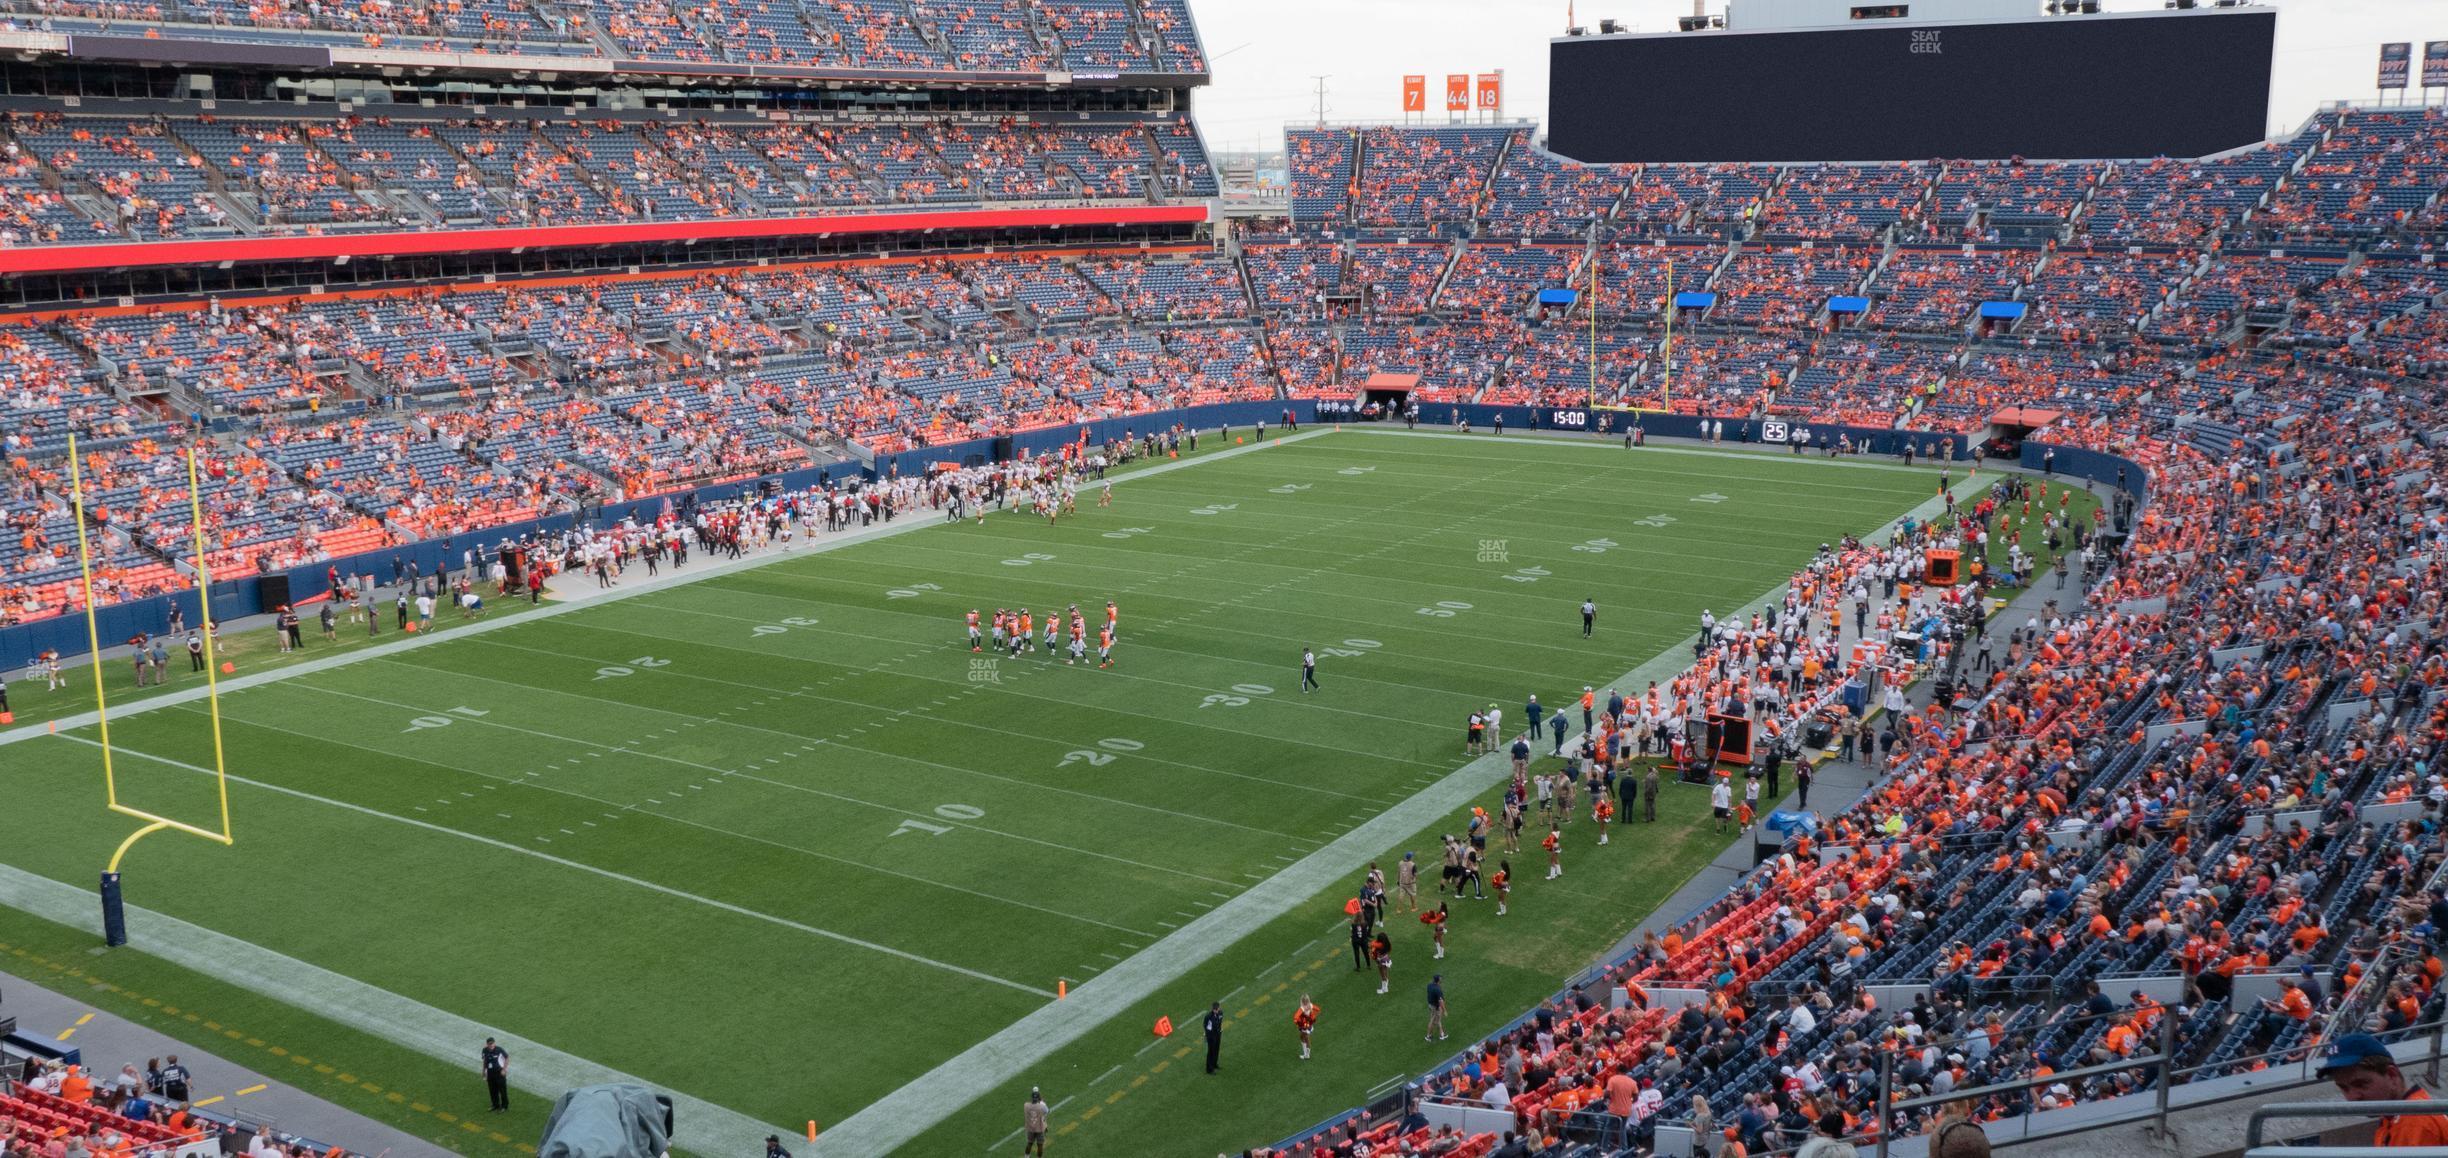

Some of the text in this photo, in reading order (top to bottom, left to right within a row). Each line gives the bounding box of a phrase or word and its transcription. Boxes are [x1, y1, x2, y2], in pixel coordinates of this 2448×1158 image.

[2380, 60, 2407, 72] 1997
[1409, 91, 1418, 106] 7
[1448, 91, 1467, 106] 44
[1480, 90, 1496, 105] 18
[1553, 411, 1585, 425] 15:00
[1766, 424, 1784, 438] 25
[1268, 484, 1308, 494] 20
[1190, 504, 1236, 515] 30
[1633, 516, 1677, 527] 20
[1102, 528, 1150, 539] 40
[1571, 540, 1619, 553] 30
[1000, 553, 1056, 566] 50
[1501, 568, 1552, 582] 40
[886, 583, 943, 597] 40
[1415, 601, 1474, 618] 50
[753, 617, 819, 634] 30
[1321, 639, 1383, 657] 40
[596, 656, 671, 676] 20
[1204, 684, 1274, 707] 30
[410, 706, 490, 727] 10
[1064, 738, 1144, 767] 20
[899, 803, 985, 836] 10
[1352, 901, 1360, 912] 10
[1162, 1020, 1170, 1032] G
